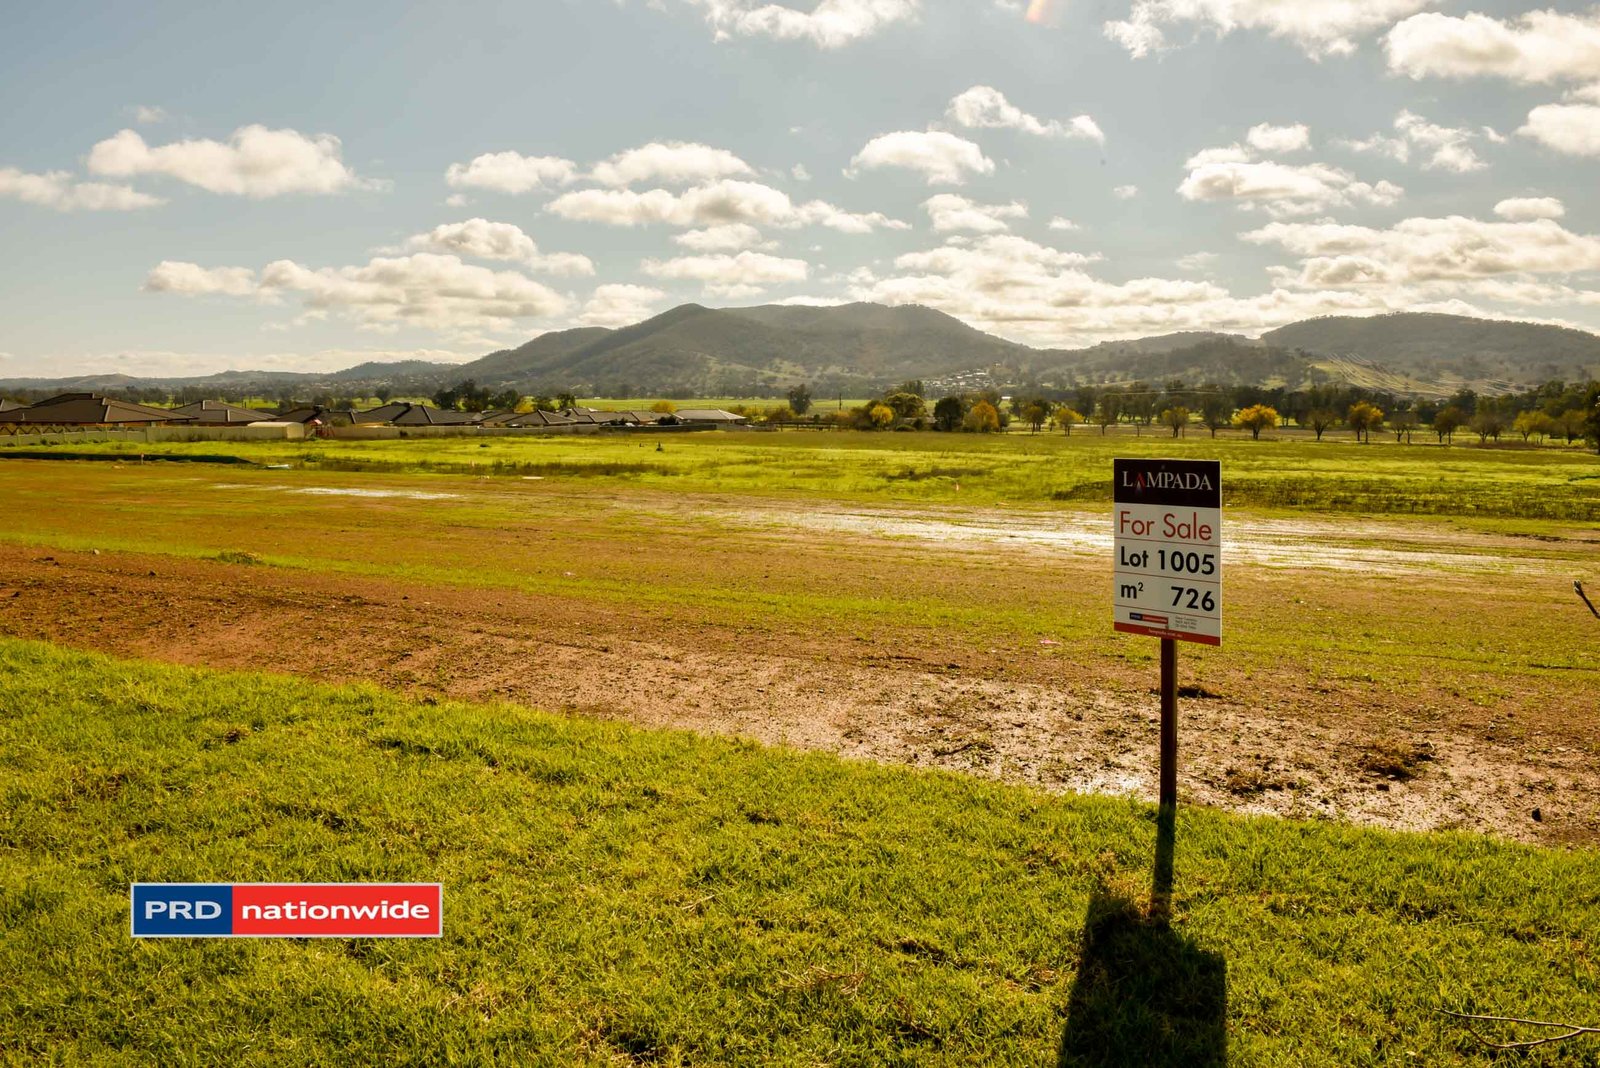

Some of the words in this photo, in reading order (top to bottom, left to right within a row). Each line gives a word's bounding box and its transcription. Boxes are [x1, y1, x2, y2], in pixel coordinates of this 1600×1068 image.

[1122, 470, 1213, 491] LAMPADA
[1120, 511, 1155, 536] For
[1163, 512, 1212, 541] Sale
[1120, 546, 1149, 568] Lot
[1158, 549, 1215, 575] 1005
[1120, 582, 1144, 599] m²
[1171, 586, 1215, 612] 726
